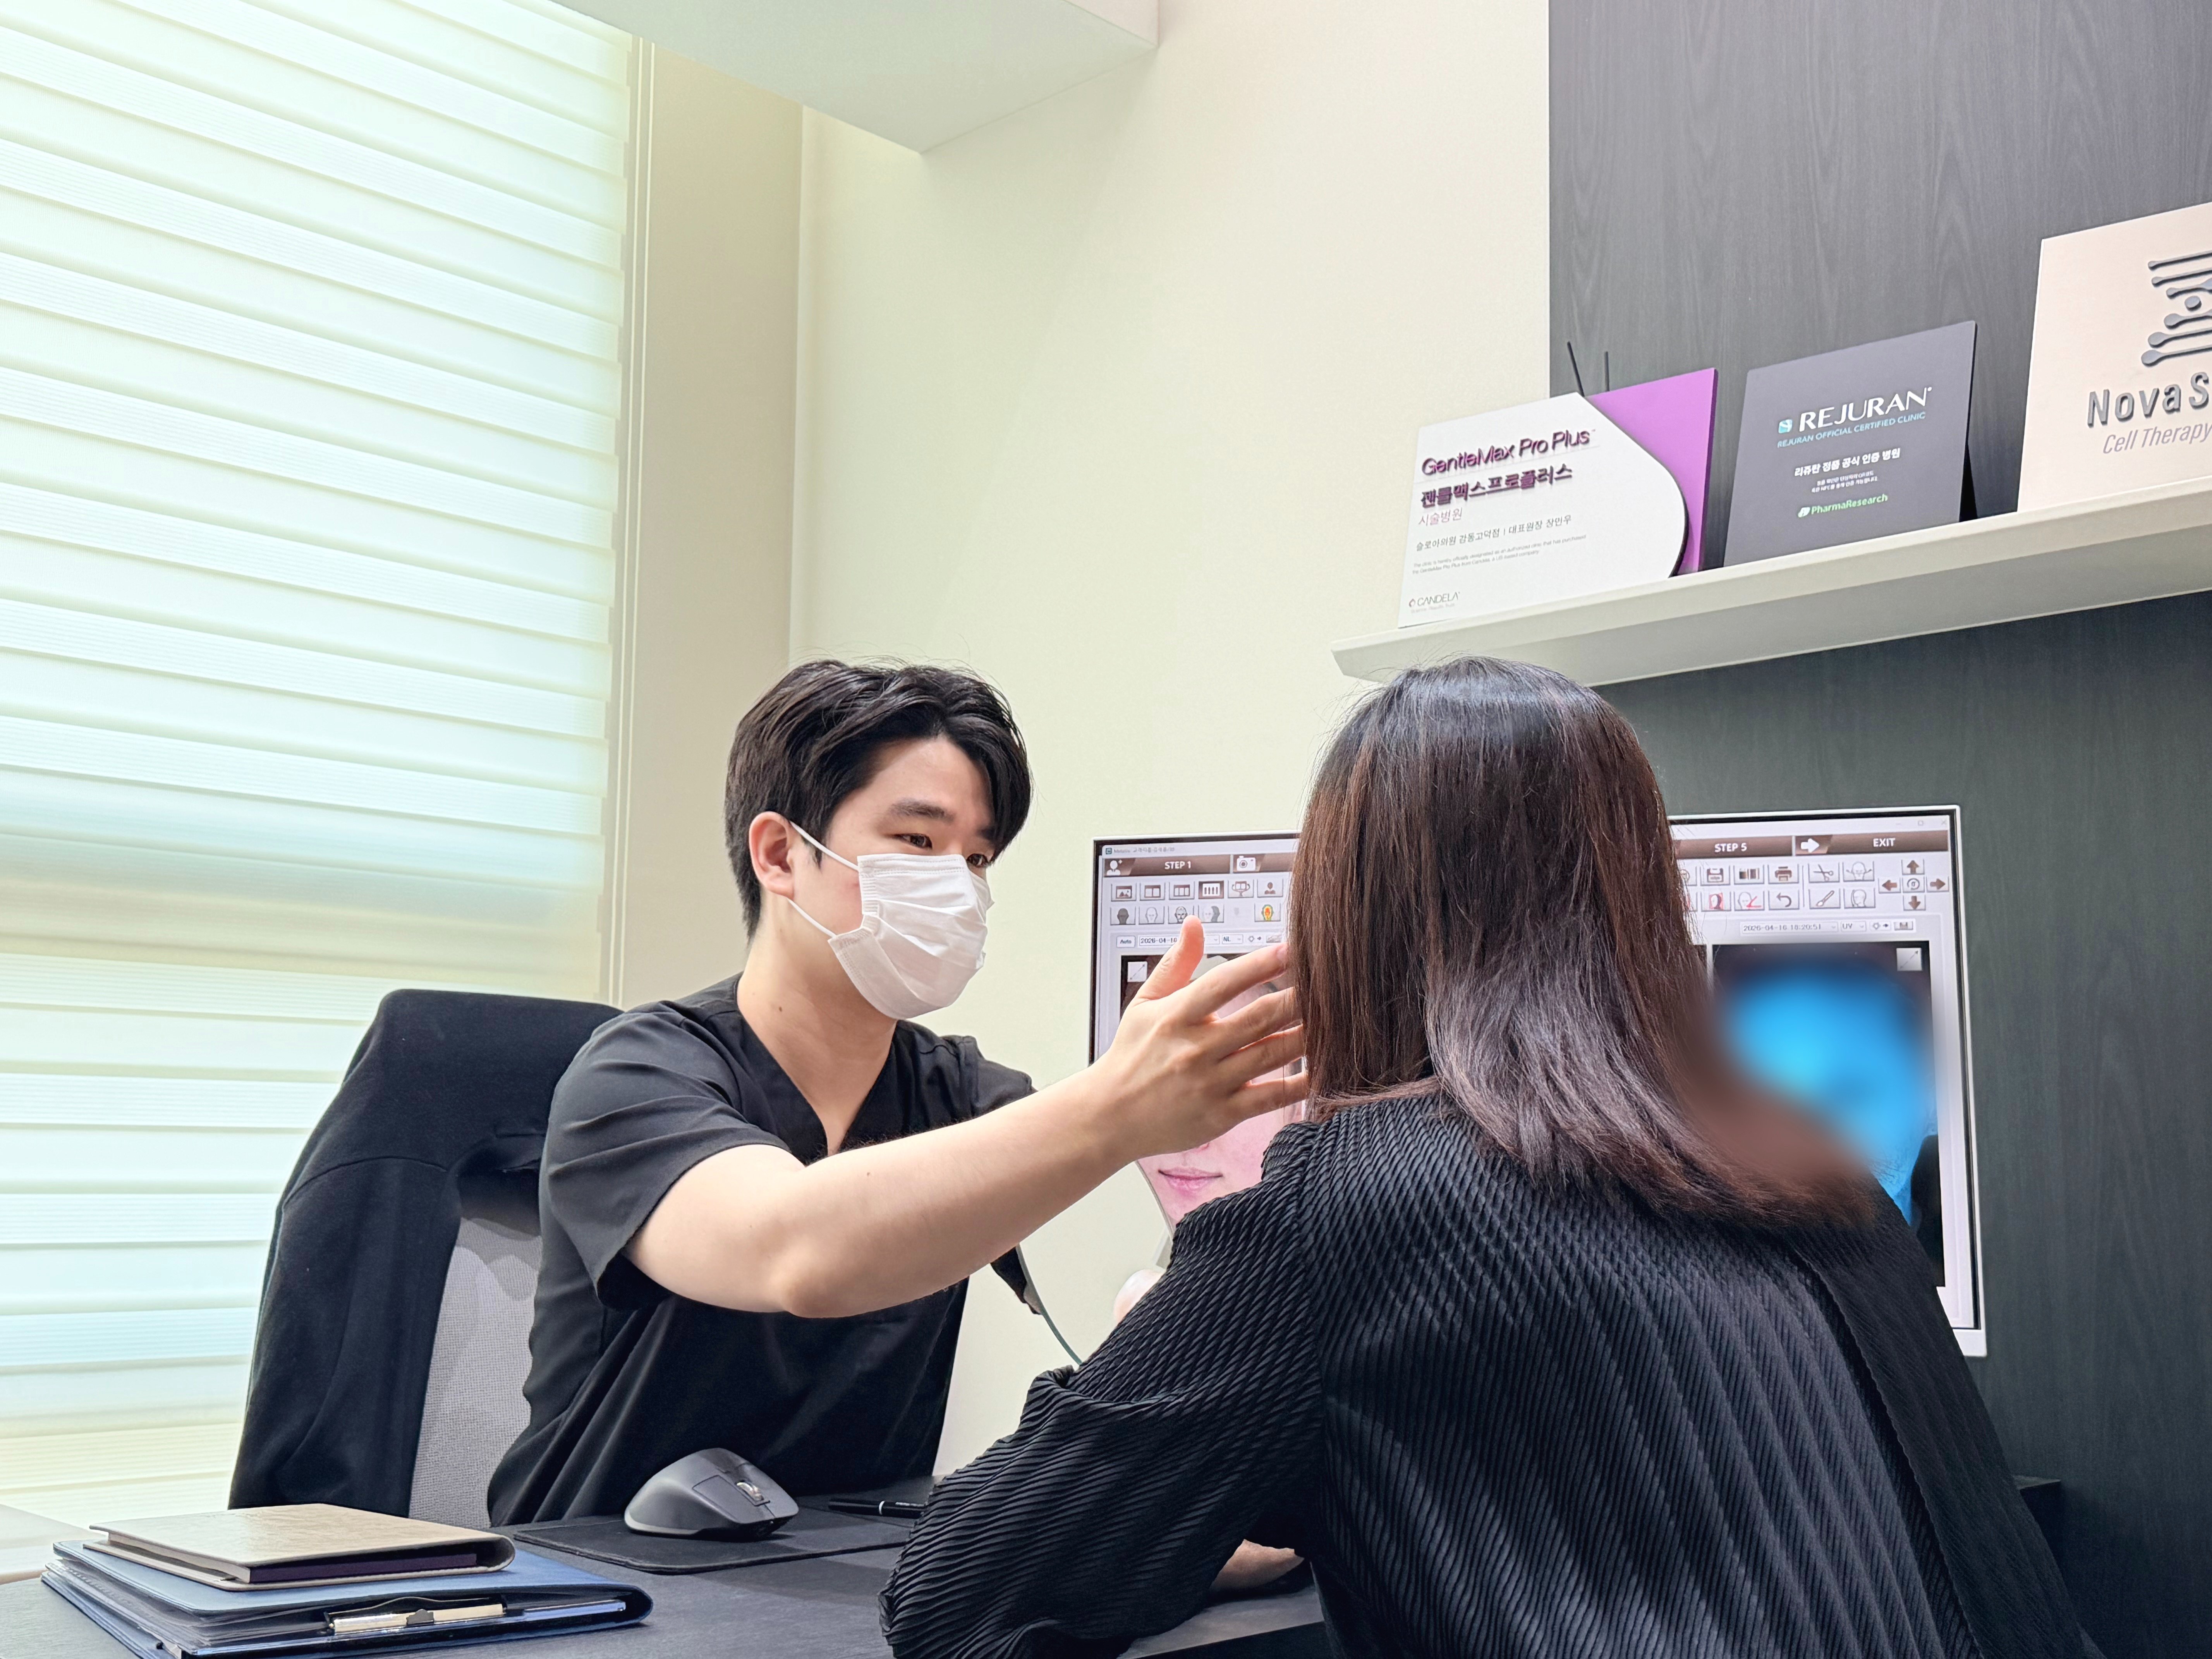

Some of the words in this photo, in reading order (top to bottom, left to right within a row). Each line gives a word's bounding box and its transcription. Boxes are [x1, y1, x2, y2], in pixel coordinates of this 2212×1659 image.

[1799, 387, 1927, 432] REJURAN
[1777, 435, 1814, 448] REJURAN
[1815, 428, 1852, 440] OFFICIAL
[1853, 418, 1896, 433] CERTIFIED
[1897, 411, 1926, 423] CLINIC
[2103, 429, 2138, 454] Cell
[2141, 422, 2212, 448] Therapy
[1422, 444, 1515, 476] GentleMax
[1518, 438, 1548, 457] Pro
[1551, 429, 1590, 450] Plus
[1794, 463, 1821, 477] 리쥬란
[1842, 456, 1860, 469] 공식
[1862, 452, 1880, 465] 인증
[1882, 448, 1901, 461] 병원
[1417, 507, 1463, 526] 시술병원
[1811, 493, 1888, 515] PharmaResearch
[1416, 536, 1456, 552] 슬로아의원
[1508, 519, 1543, 534] 대표원장
[1417, 592, 1458, 606] CANDELA
[1714, 843, 1738, 853] STEP
[1741, 842, 1747, 851] 5
[1873, 838, 1896, 847] EXIT
[1164, 861, 1185, 870] STEP
[1187, 861, 1192, 869] 1
